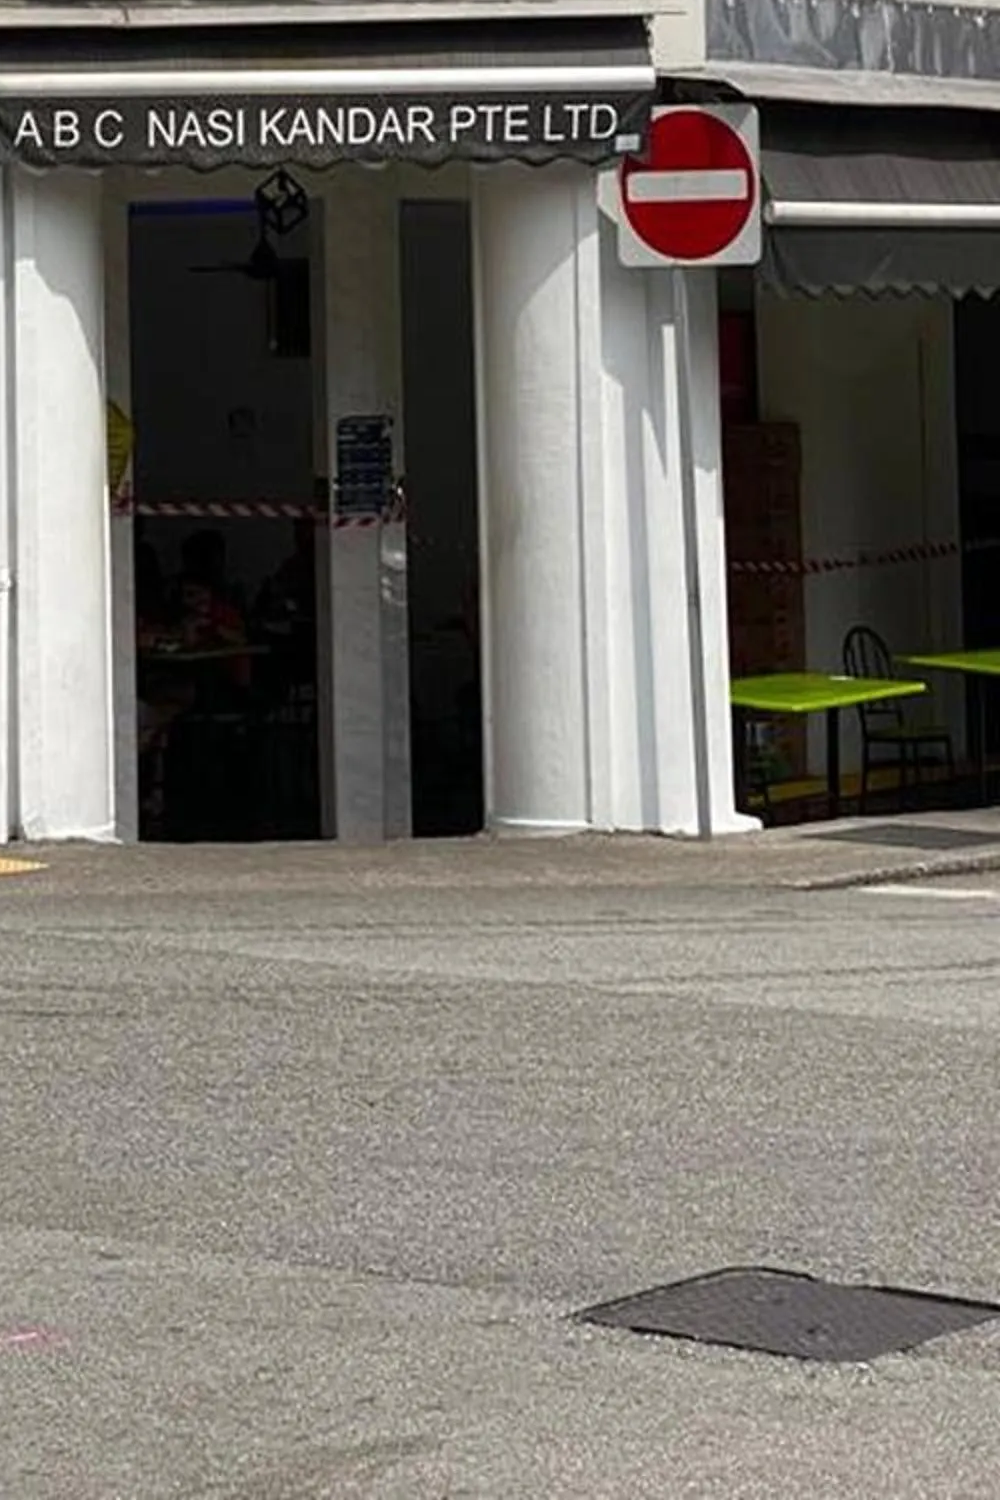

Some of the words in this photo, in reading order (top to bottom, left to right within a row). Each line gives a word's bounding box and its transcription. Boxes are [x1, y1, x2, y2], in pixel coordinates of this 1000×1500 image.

[147, 107, 245, 148] NASI
[258, 105, 437, 147] KANDAR
[450, 104, 530, 143] PTE
[543, 103, 618, 142] LTD
